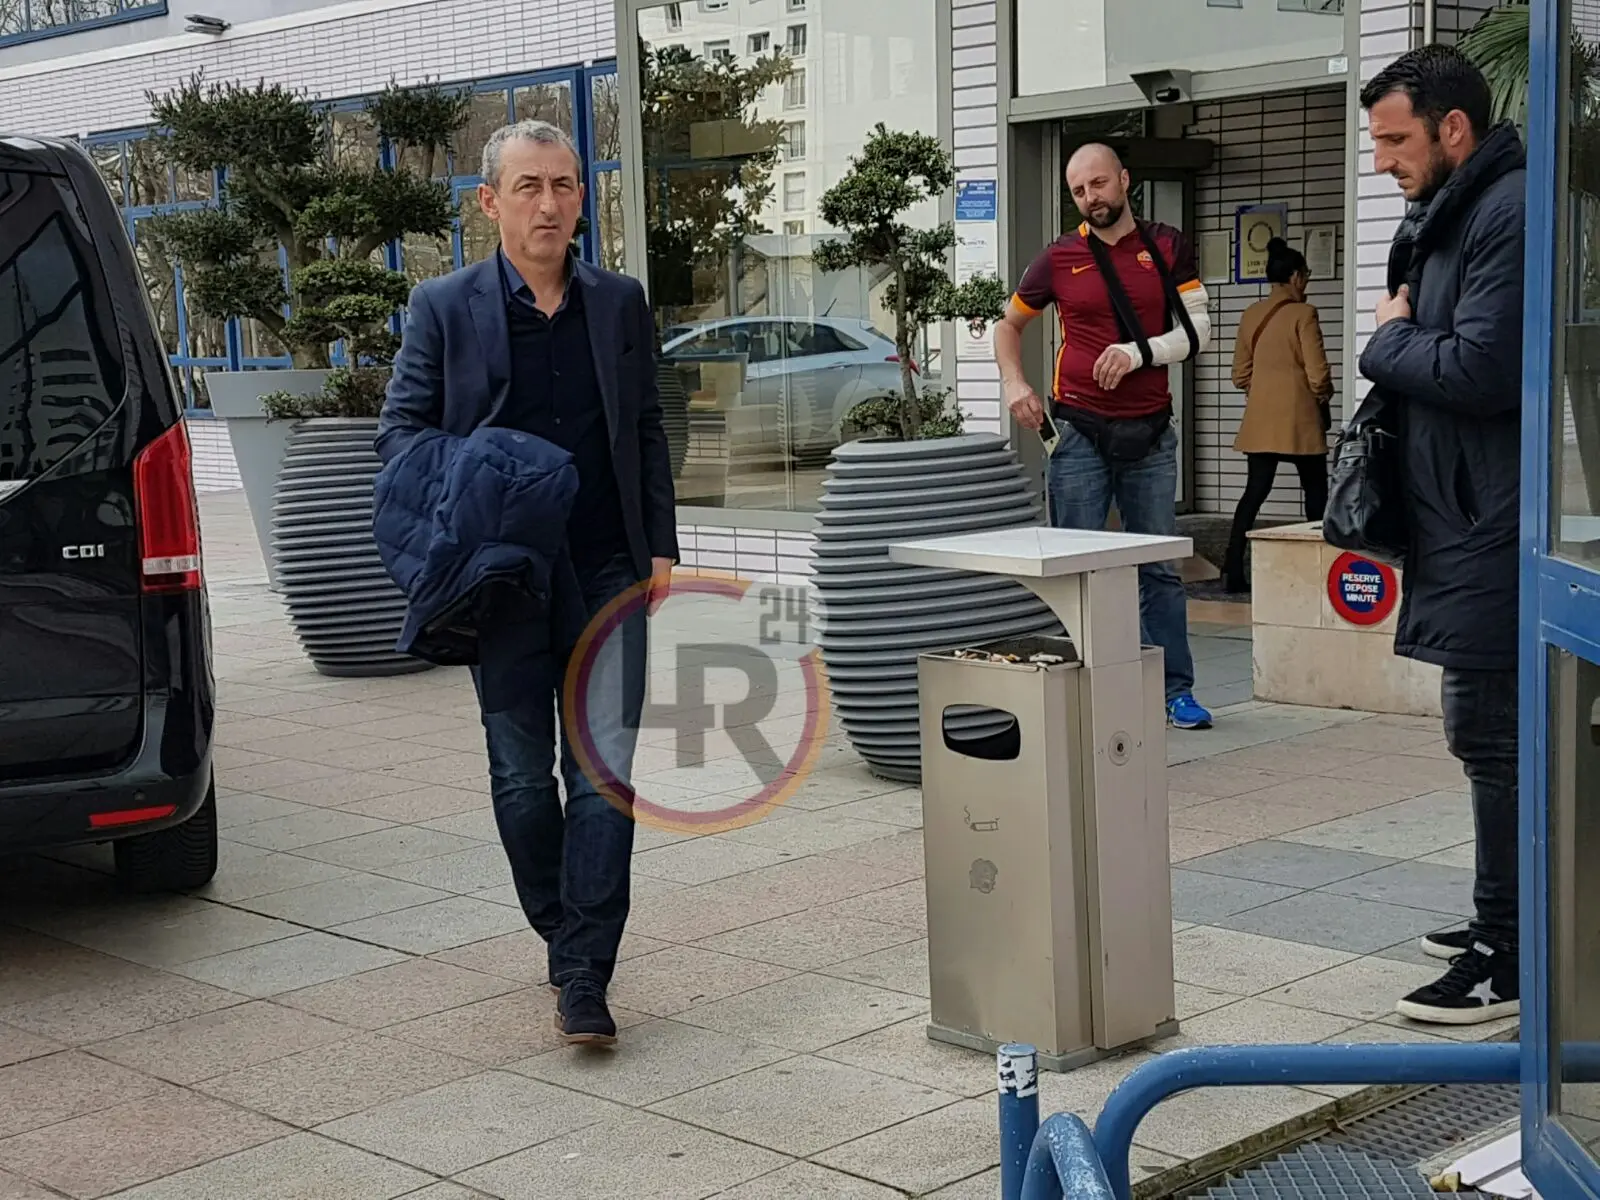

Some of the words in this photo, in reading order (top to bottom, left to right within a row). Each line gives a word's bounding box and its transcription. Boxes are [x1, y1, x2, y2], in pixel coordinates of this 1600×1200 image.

[62, 544, 105, 559] CDI
[1342, 572, 1381, 583] RESERVE
[1344, 583, 1379, 593] DEPOSE
[1346, 594, 1377, 603] MINUTE
